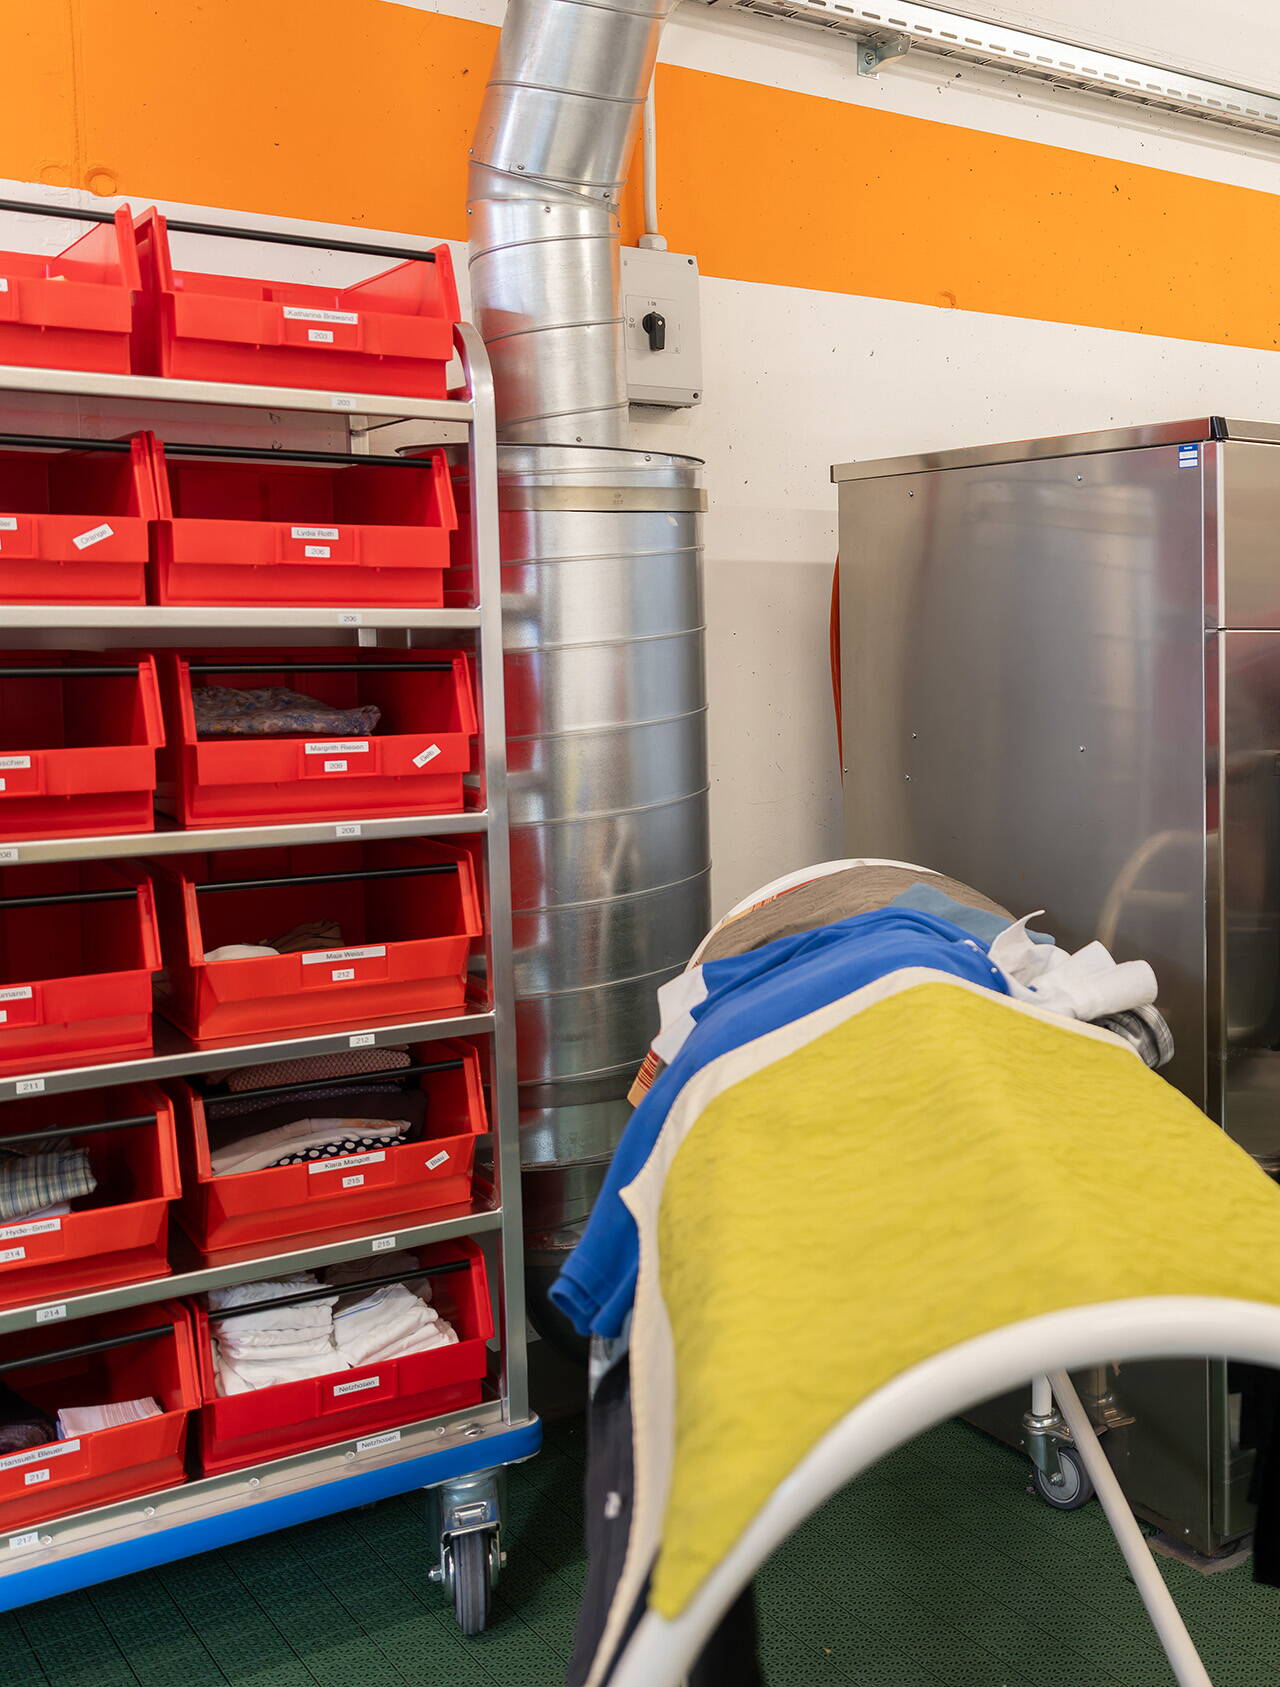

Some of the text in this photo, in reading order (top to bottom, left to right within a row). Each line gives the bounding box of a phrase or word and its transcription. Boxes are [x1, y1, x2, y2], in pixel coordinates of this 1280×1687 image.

[23, 1082, 39, 1091] 211
[346, 1177, 361, 1185] 215
[4, 1250, 20, 1258] 214
[43, 1310, 60, 1318] 214
[338, 1380, 376, 1393] Netzhosen
[361, 1434, 397, 1449] Netzhosen
[30, 1472, 46, 1481] 217
